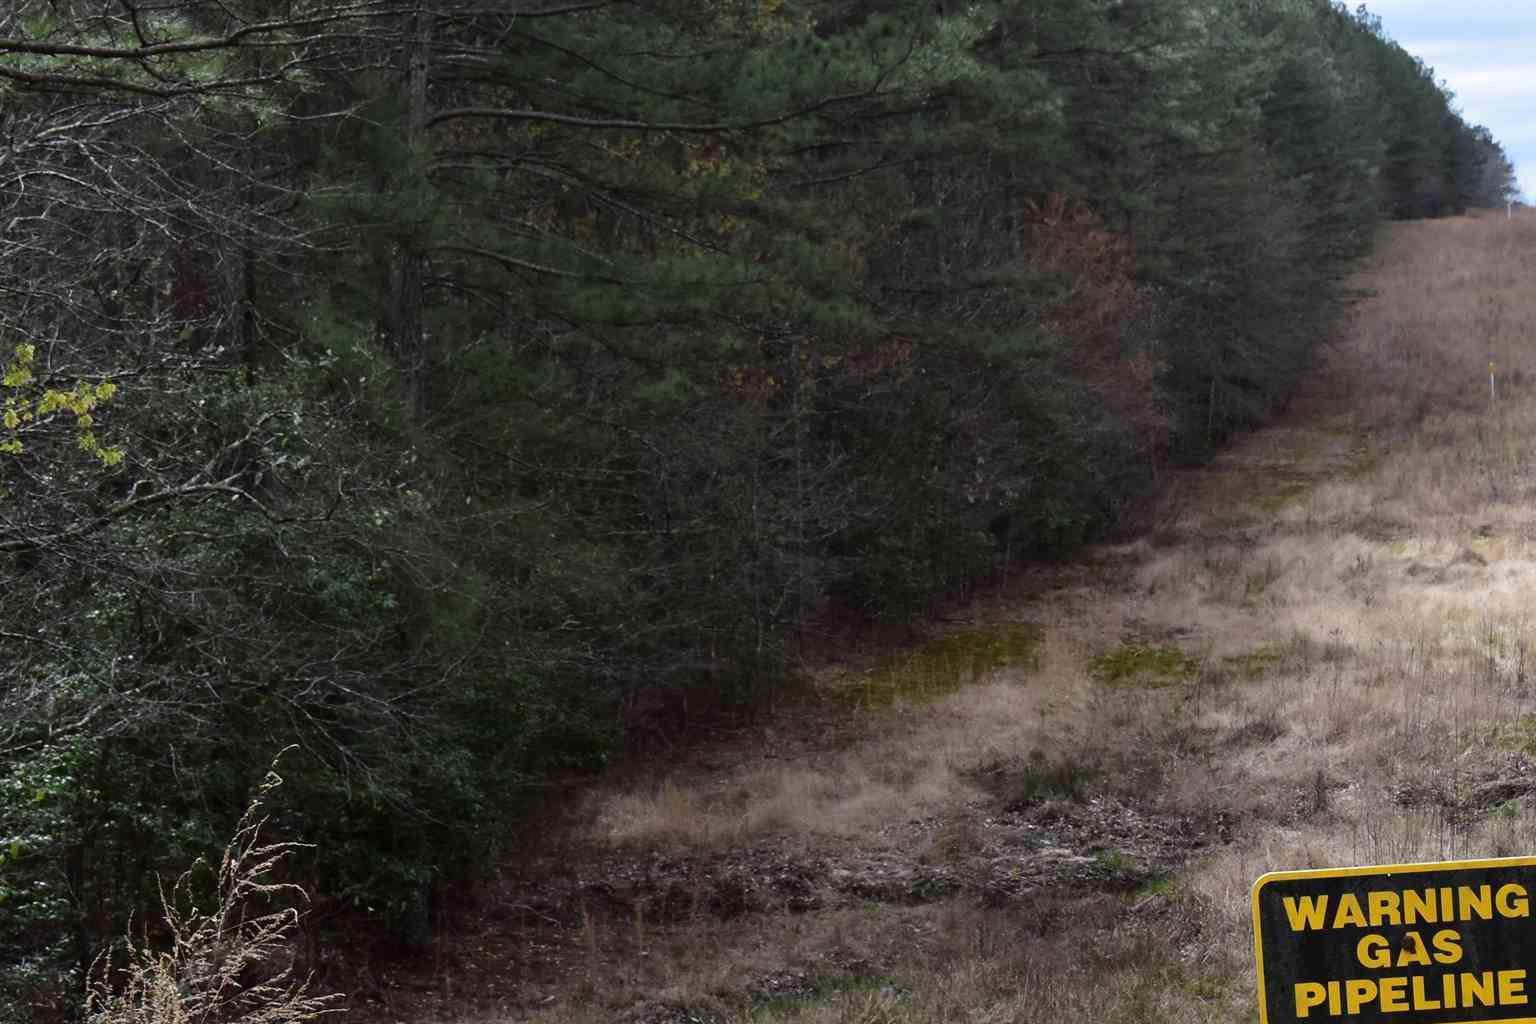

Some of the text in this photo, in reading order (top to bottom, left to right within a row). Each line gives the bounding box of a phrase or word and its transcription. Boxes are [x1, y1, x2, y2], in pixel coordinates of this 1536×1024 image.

[1283, 883, 1530, 931] WARNING
[1356, 929, 1463, 969] GAS
[1294, 969, 1529, 1018] PIPELINE
